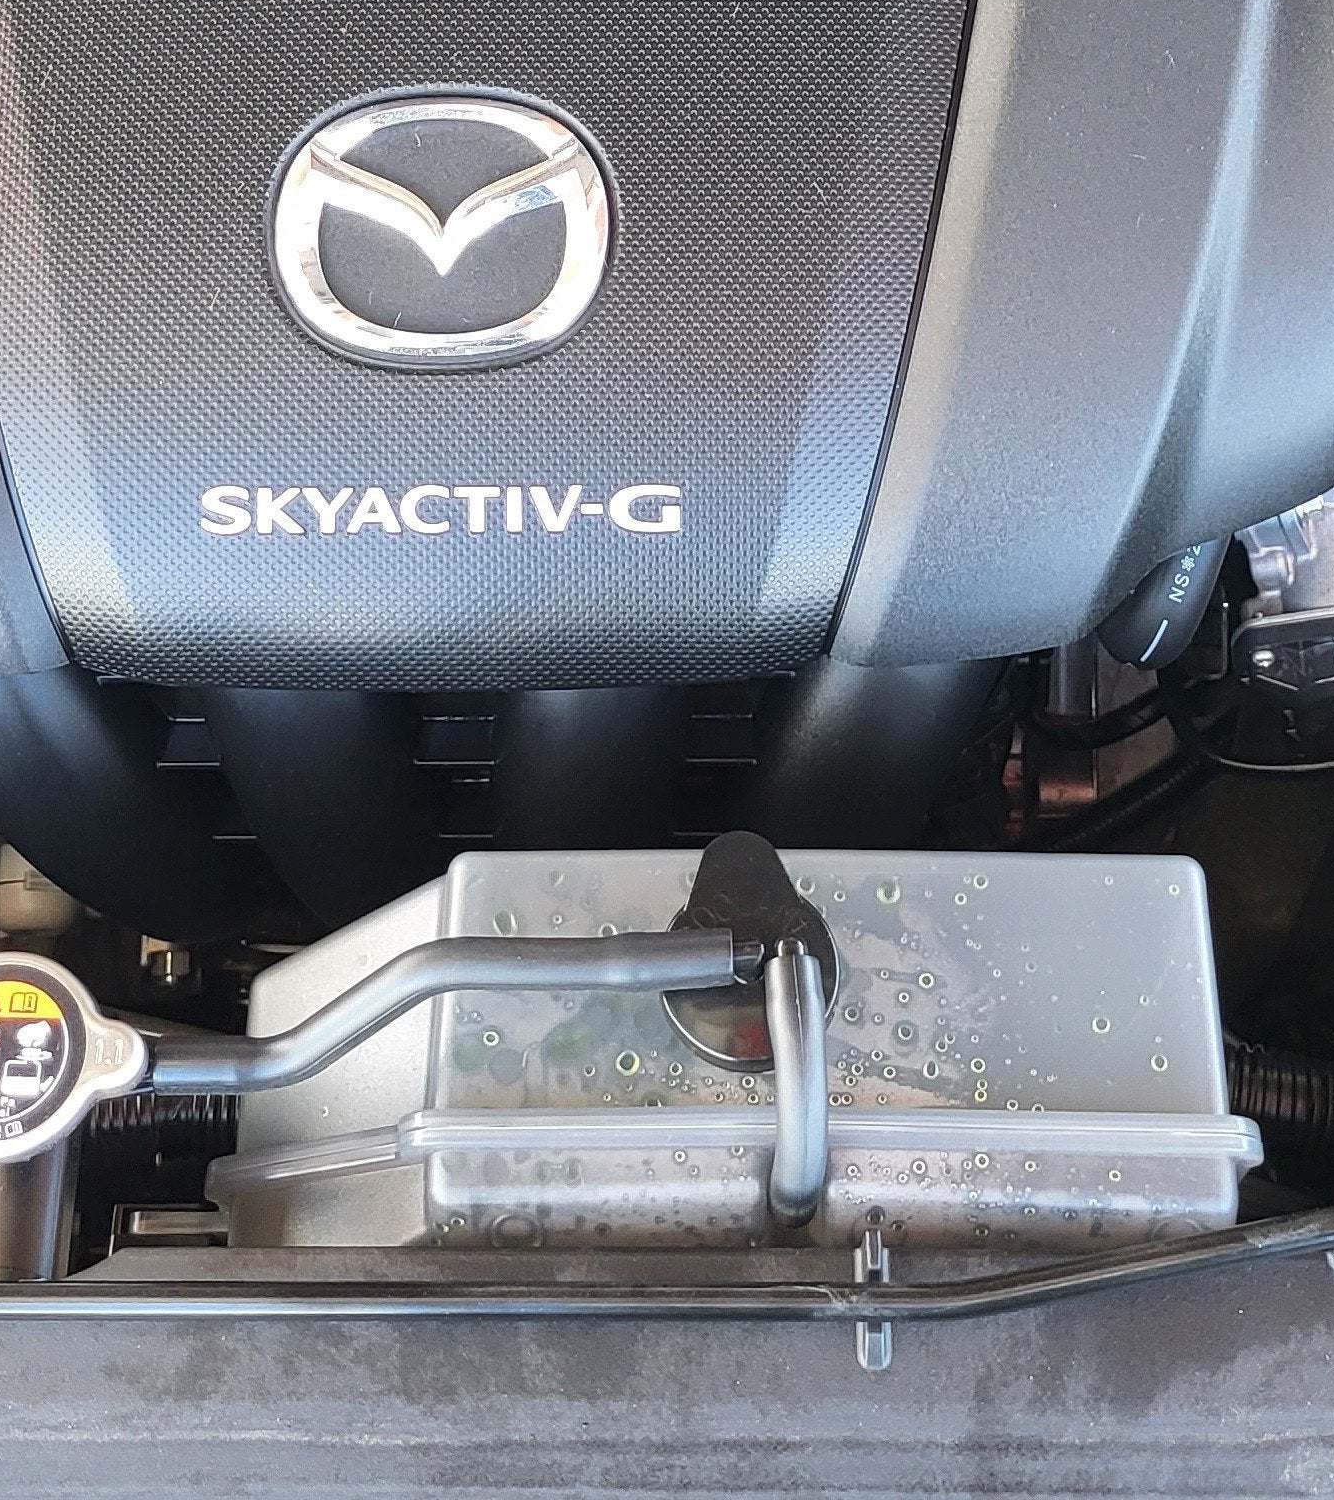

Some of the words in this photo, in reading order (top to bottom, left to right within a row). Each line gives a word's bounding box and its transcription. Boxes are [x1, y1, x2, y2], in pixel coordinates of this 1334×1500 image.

[199, 484, 682, 536] SKYACTIV-G
[1168, 573, 1190, 603] NS
[95, 1038, 124, 1066] 1.1
